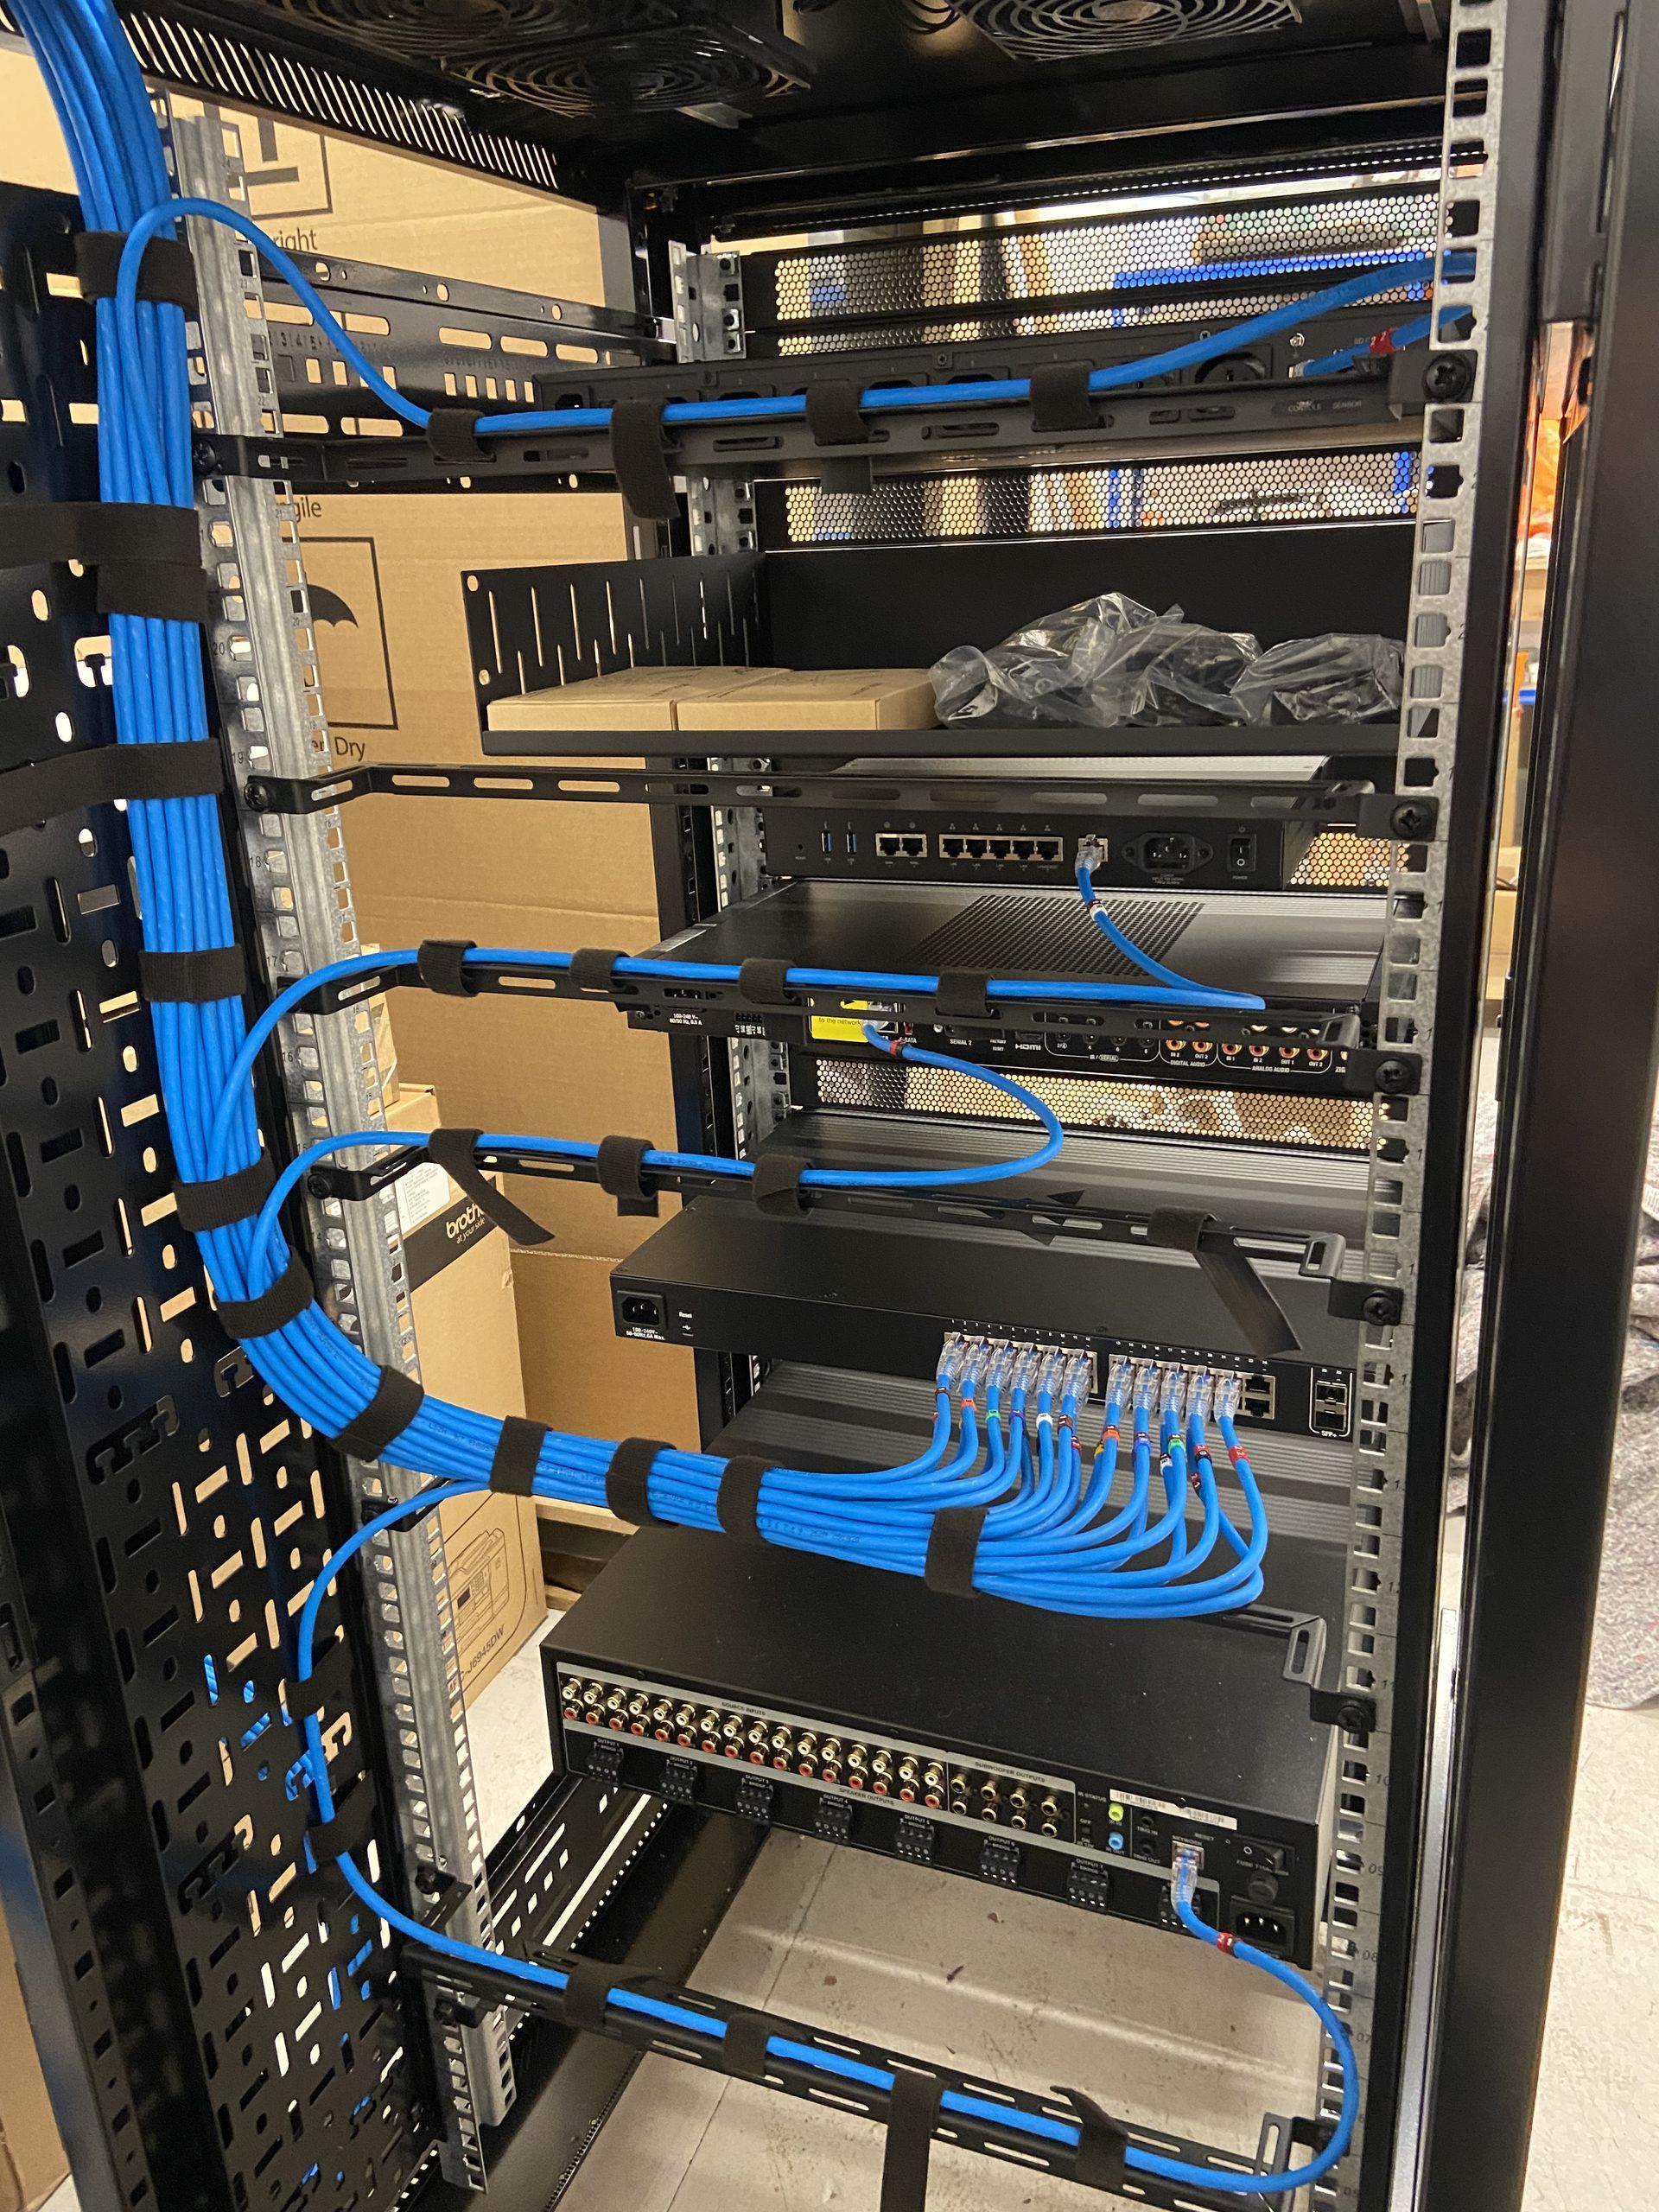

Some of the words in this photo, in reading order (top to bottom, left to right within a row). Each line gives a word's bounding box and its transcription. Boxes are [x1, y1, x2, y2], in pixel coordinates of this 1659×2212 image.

[273, 227, 317, 251] right
[334, 736, 365, 762] Dry
[250, 855, 262, 868] 18
[266, 956, 277, 969] 17
[282, 1051, 294, 1063] 16
[446, 1202, 485, 1239] broth
[456, 1236, 463, 1244] at
[463, 1228, 475, 1242] your
[746, 1707, 766, 1716] INPUTS
[597, 1738, 615, 1747] OUTPUT
[670, 1756, 688, 1765] OUTPUT
[975, 1761, 1014, 1777] SUBWOOFER
[1015, 1771, 1046, 1783] OUTPUTS
[745, 1774, 764, 1783] OUTPUT
[823, 1794, 843, 1802] OUTPUT
[839, 1787, 866, 1799] SPEAKER
[867, 1794, 895, 1806] OUTPUTS
[1084, 1792, 1107, 1802] STATUS
[904, 1815, 925, 1823] OUTPUT
[988, 1835, 1009, 1845] OUTPUT
[1172, 1834, 1203, 1846] NETWORK
[1077, 1858, 1099, 1867] OUTPUT
[1362, 1949, 1378, 1963] 08
[1356, 2032, 1372, 2044] 07
